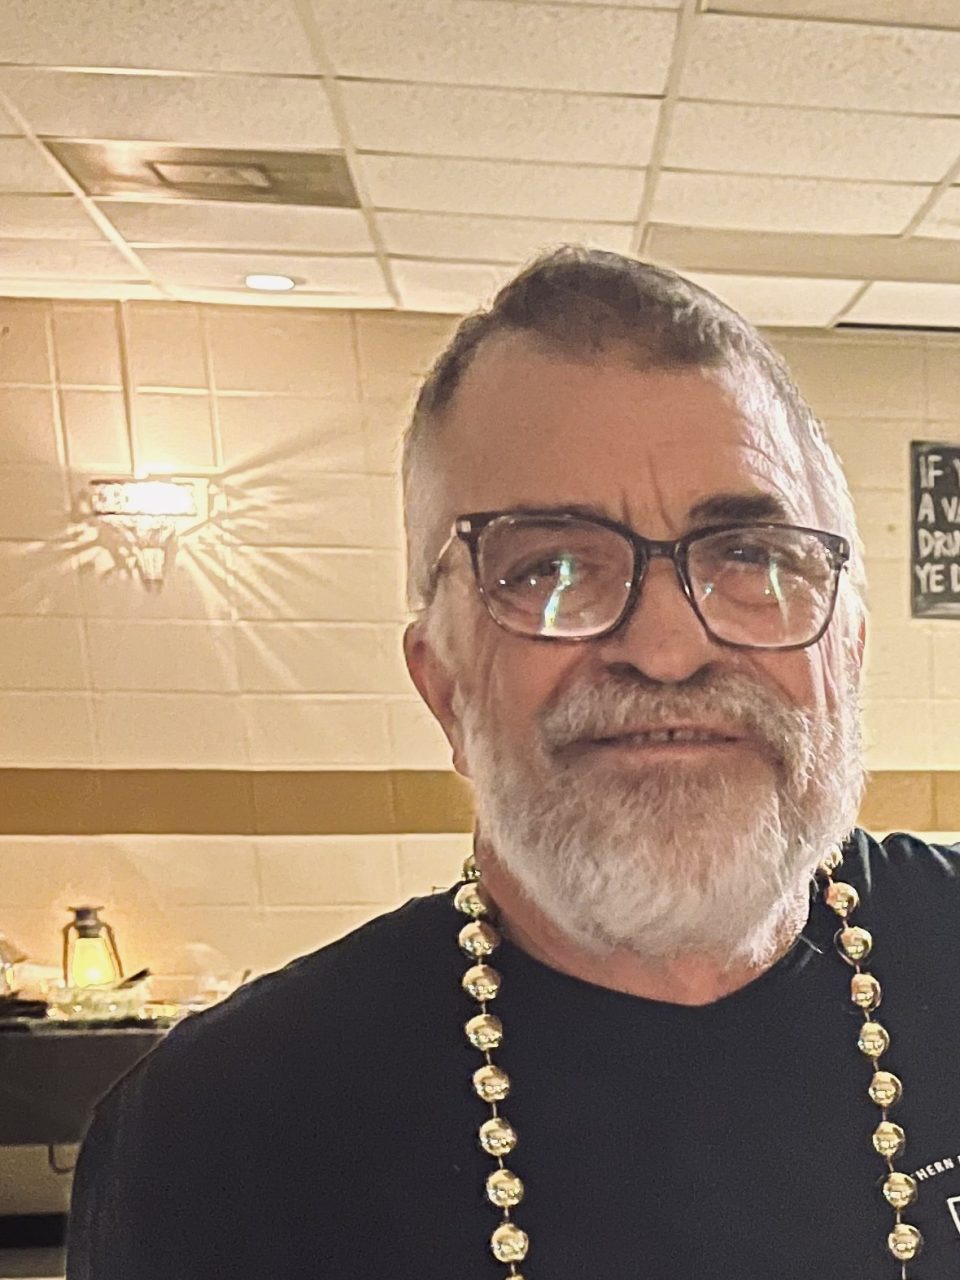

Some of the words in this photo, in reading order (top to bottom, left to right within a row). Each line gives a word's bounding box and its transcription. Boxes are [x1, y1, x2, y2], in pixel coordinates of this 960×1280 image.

[918, 454, 943, 490] IF
[917, 492, 936, 525] A
[914, 563, 945, 595] YE
[911, 1157, 955, 1182] HERN
